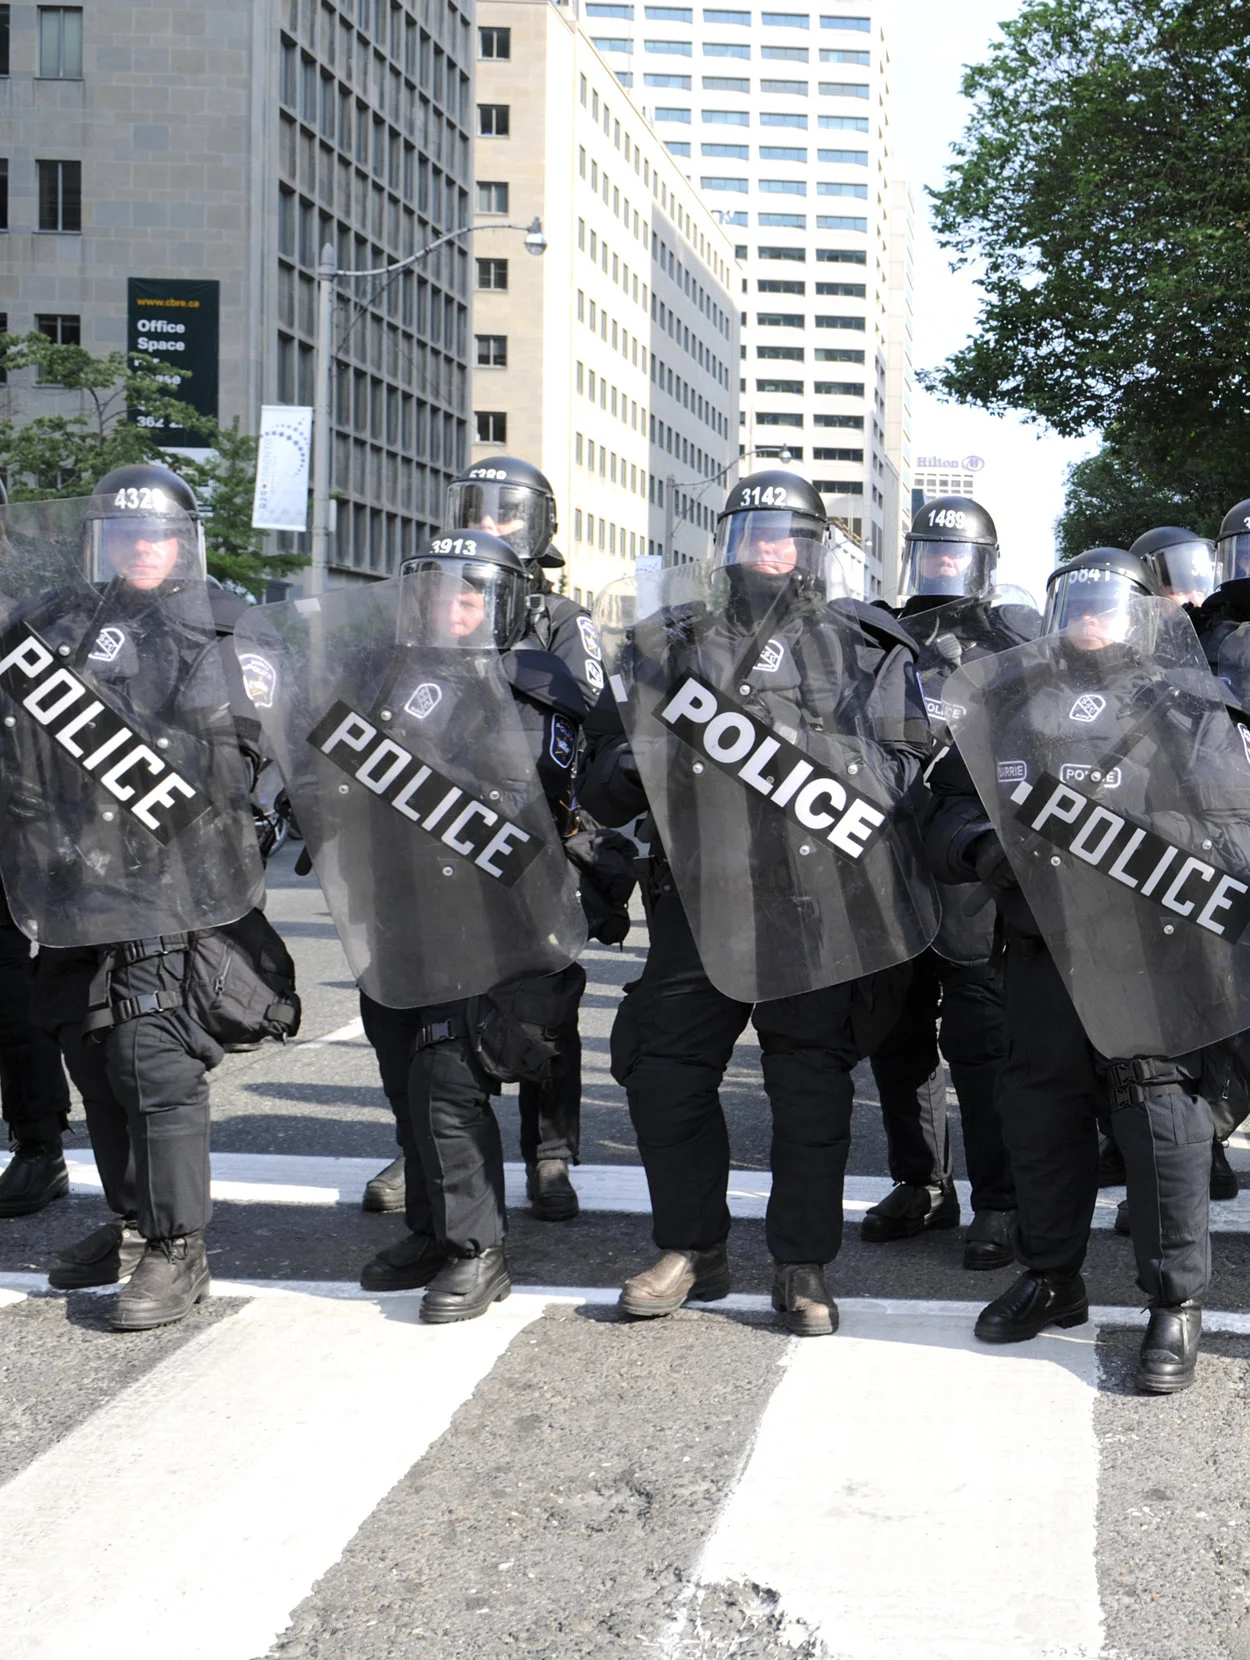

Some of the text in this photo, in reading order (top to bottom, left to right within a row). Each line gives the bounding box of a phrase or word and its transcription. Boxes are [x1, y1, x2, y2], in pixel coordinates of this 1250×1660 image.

[136, 298, 200, 308] www.cbre.ca
[136, 319, 186, 334] Office
[136, 337, 186, 352] Space
[916, 456, 959, 468] Hilton
[113, 487, 167, 510] 432
[740, 486, 787, 507] 3142
[928, 509, 967, 530] 1489
[429, 538, 477, 556] 3913
[0, 635, 196, 831] POLICE
[661, 676, 886, 860] POLICE
[320, 711, 531, 879] POLICE
[1030, 781, 1249, 935] POLICE
